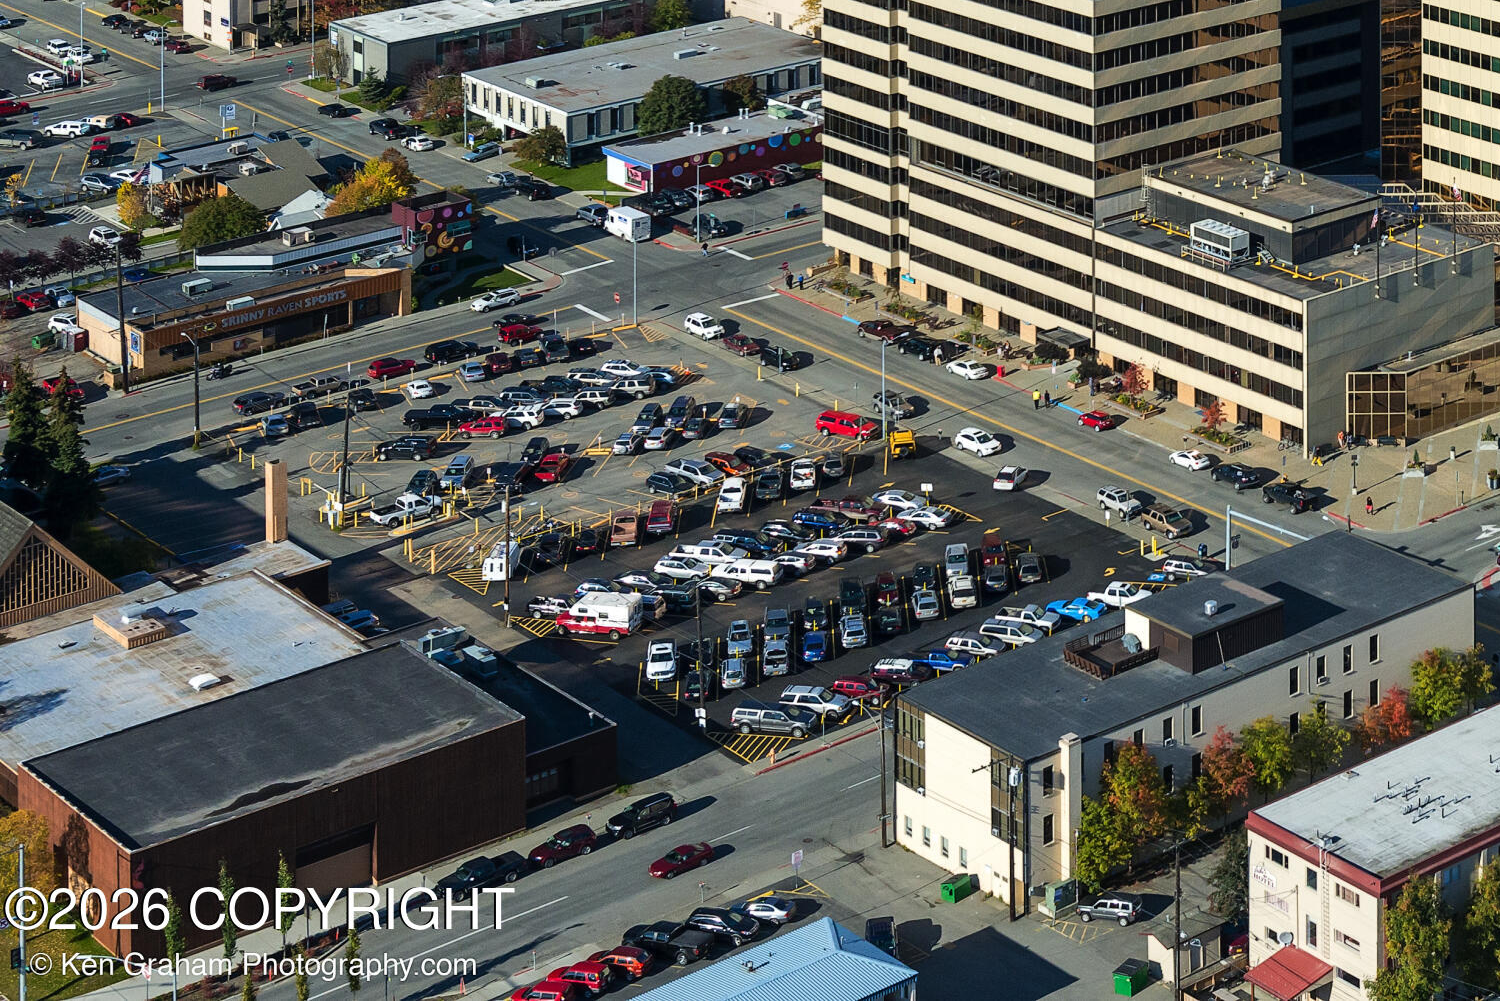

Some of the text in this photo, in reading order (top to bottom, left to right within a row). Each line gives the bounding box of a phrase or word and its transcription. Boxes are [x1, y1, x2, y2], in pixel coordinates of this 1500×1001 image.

[221, 289, 347, 328] SKINNY RAVEN SPORTS
